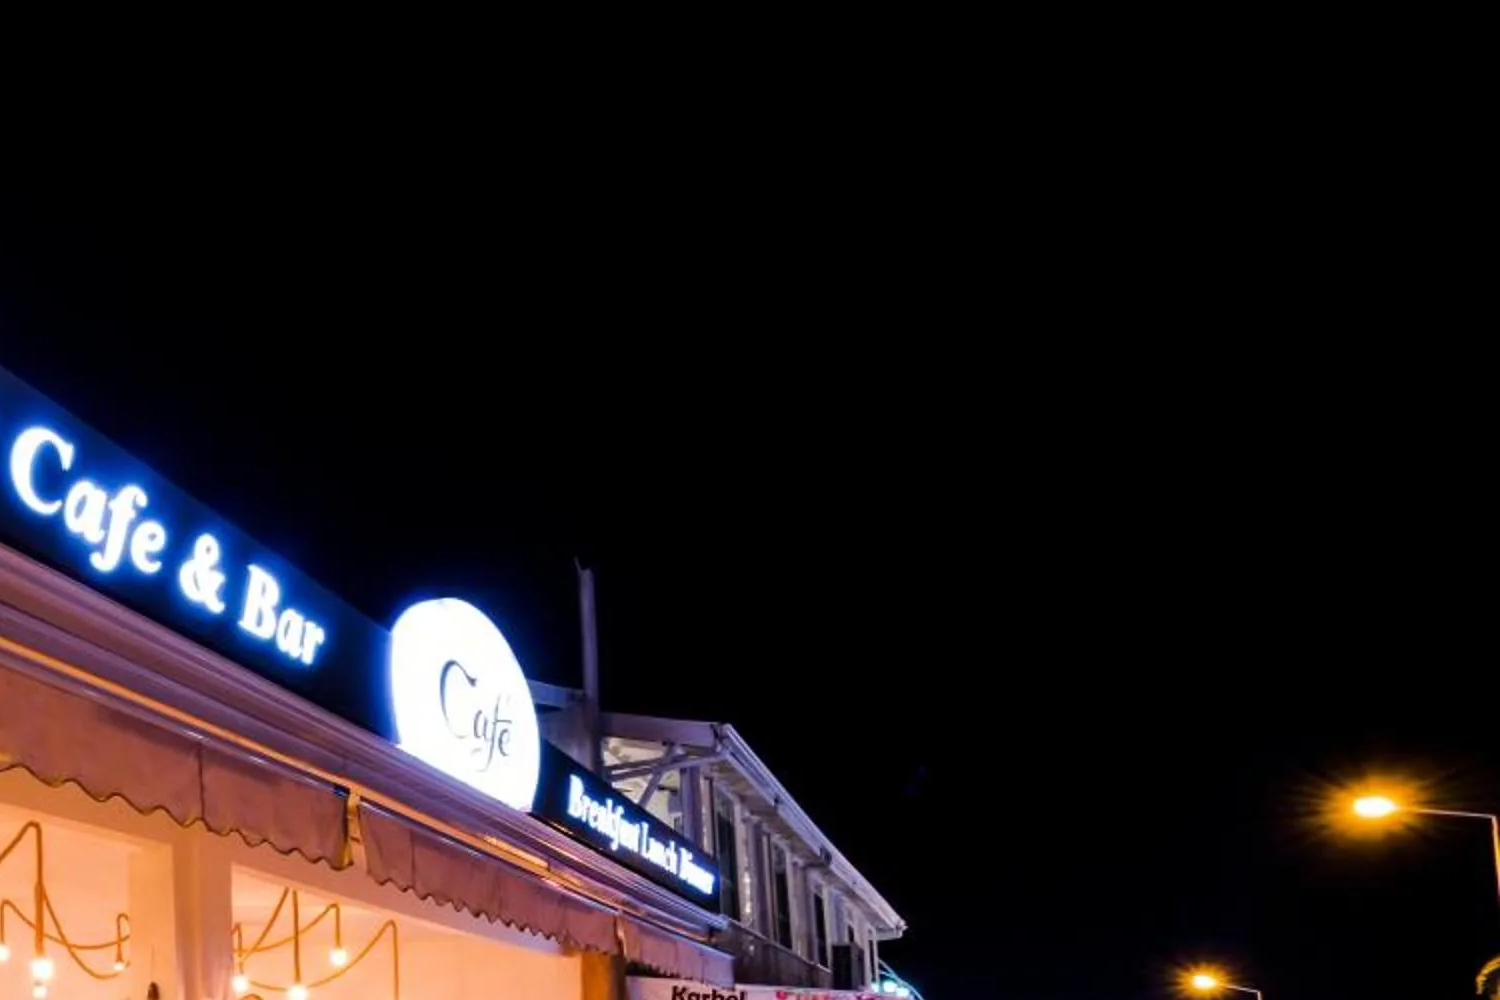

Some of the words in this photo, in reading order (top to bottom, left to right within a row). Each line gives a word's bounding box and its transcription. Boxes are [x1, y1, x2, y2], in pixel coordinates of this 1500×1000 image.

[9, 425, 166, 573] Cafe
[179, 532, 226, 613] &
[239, 564, 325, 665] Bar
